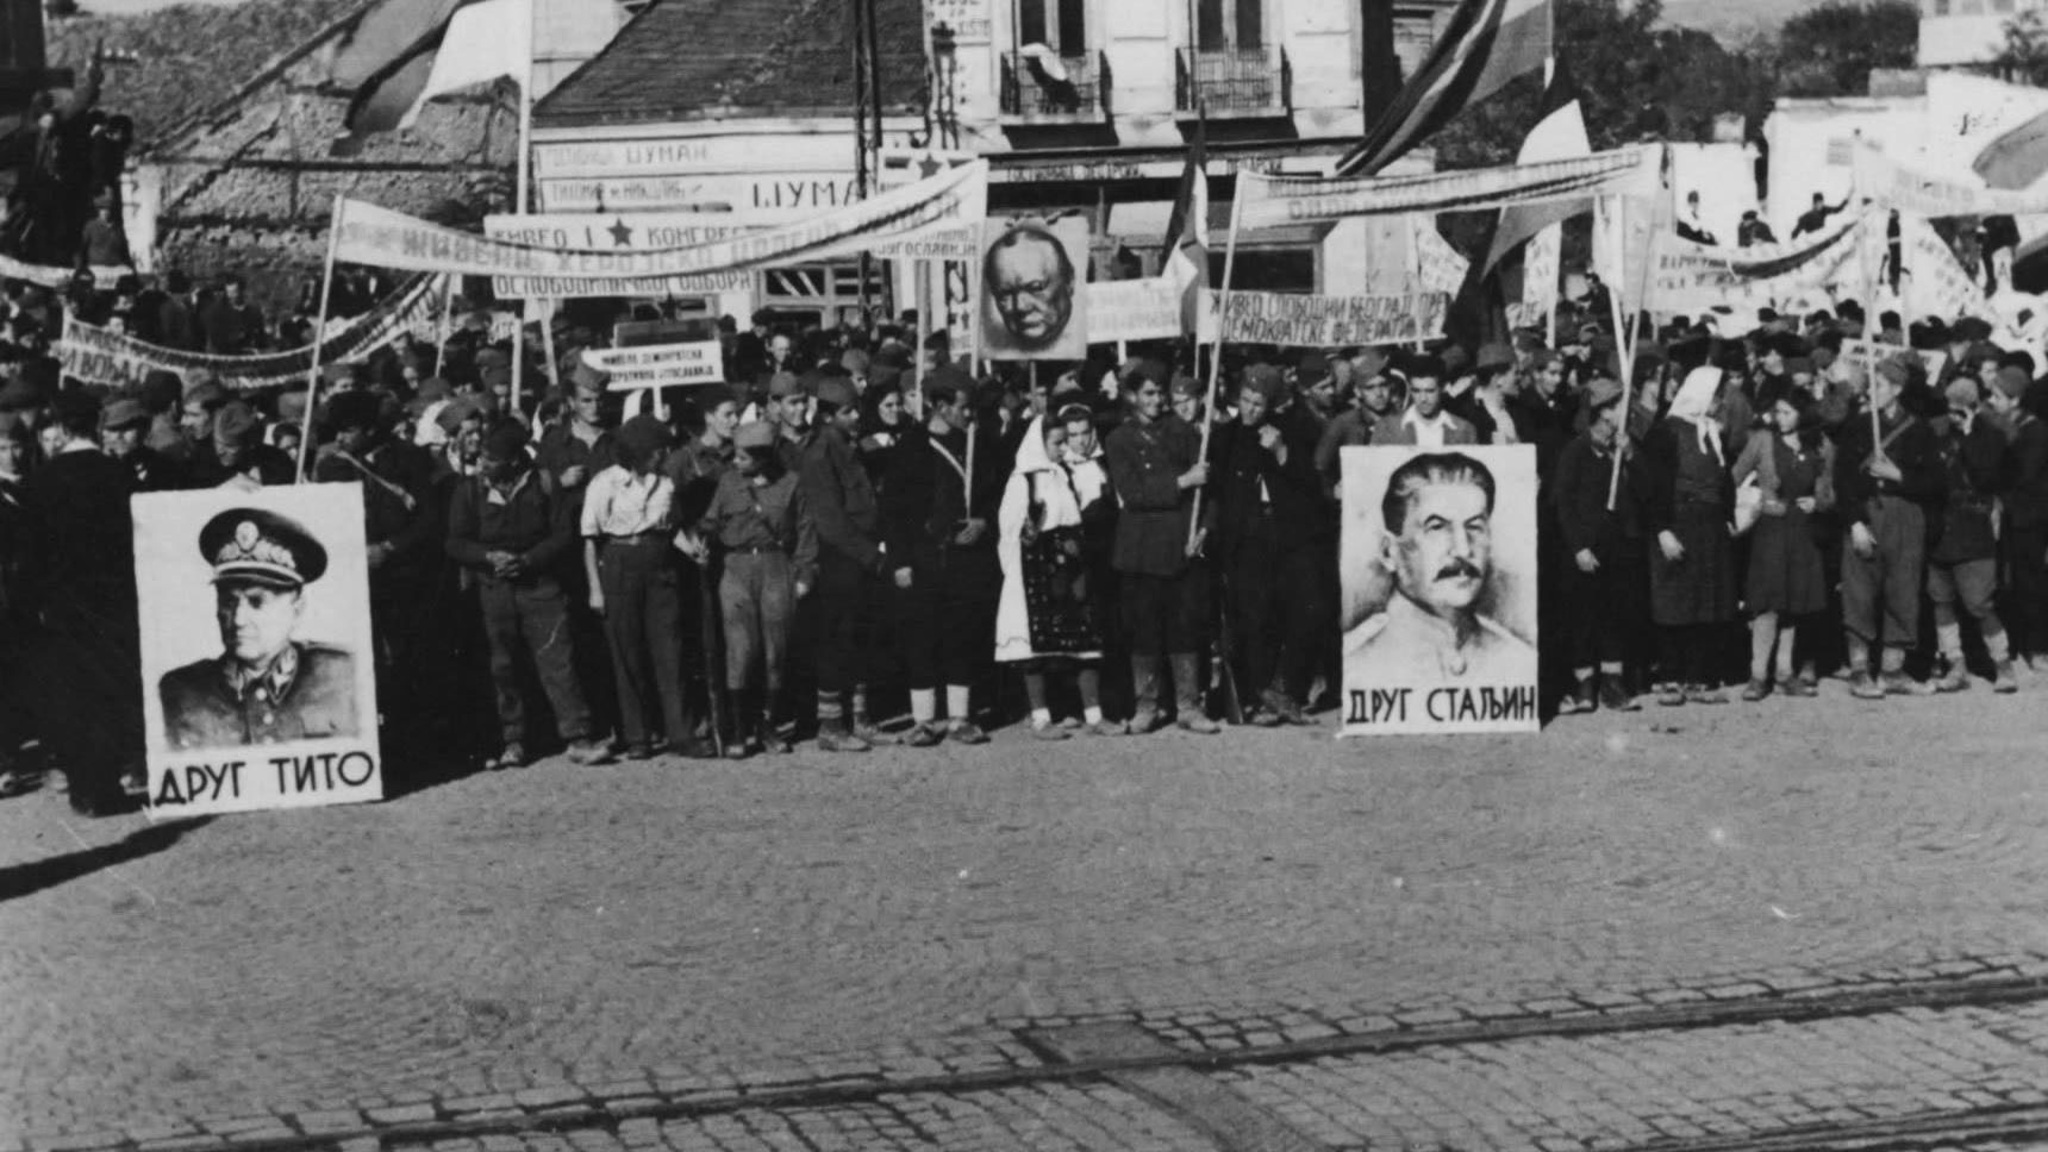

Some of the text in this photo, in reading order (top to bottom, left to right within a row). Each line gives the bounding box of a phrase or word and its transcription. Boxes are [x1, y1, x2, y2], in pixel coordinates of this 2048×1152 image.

[1346, 684, 1535, 725] ДРУГ СТАЉИН
[153, 751, 374, 807] ДРУГ ТИТО
